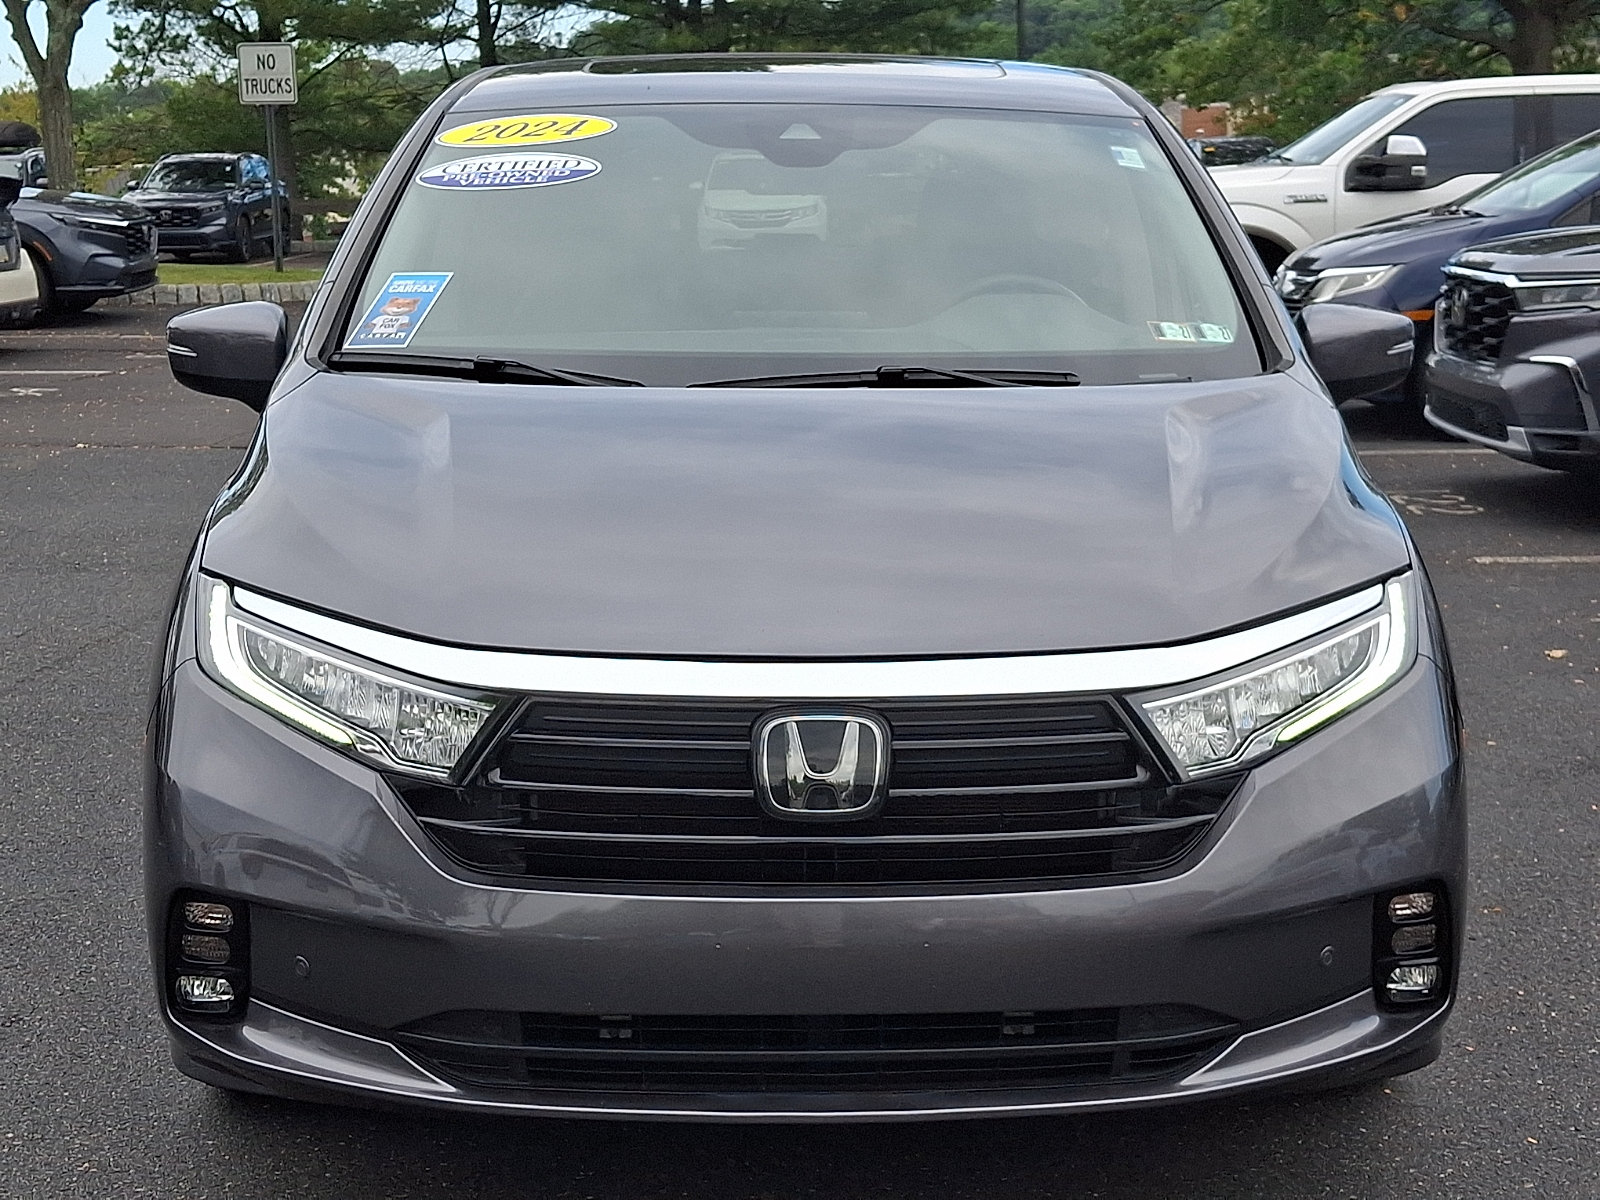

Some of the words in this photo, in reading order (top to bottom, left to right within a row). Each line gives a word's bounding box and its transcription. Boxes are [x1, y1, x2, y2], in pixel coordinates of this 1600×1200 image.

[256, 53, 276, 70] NO
[243, 77, 293, 95] TRUCKS
[462, 119, 590, 143] 2024
[443, 160, 581, 174] CERTIFIED
[443, 169, 571, 181] PRE-OWNED
[460, 175, 550, 187] VEHICLE
[388, 285, 436, 293] CARFAX
